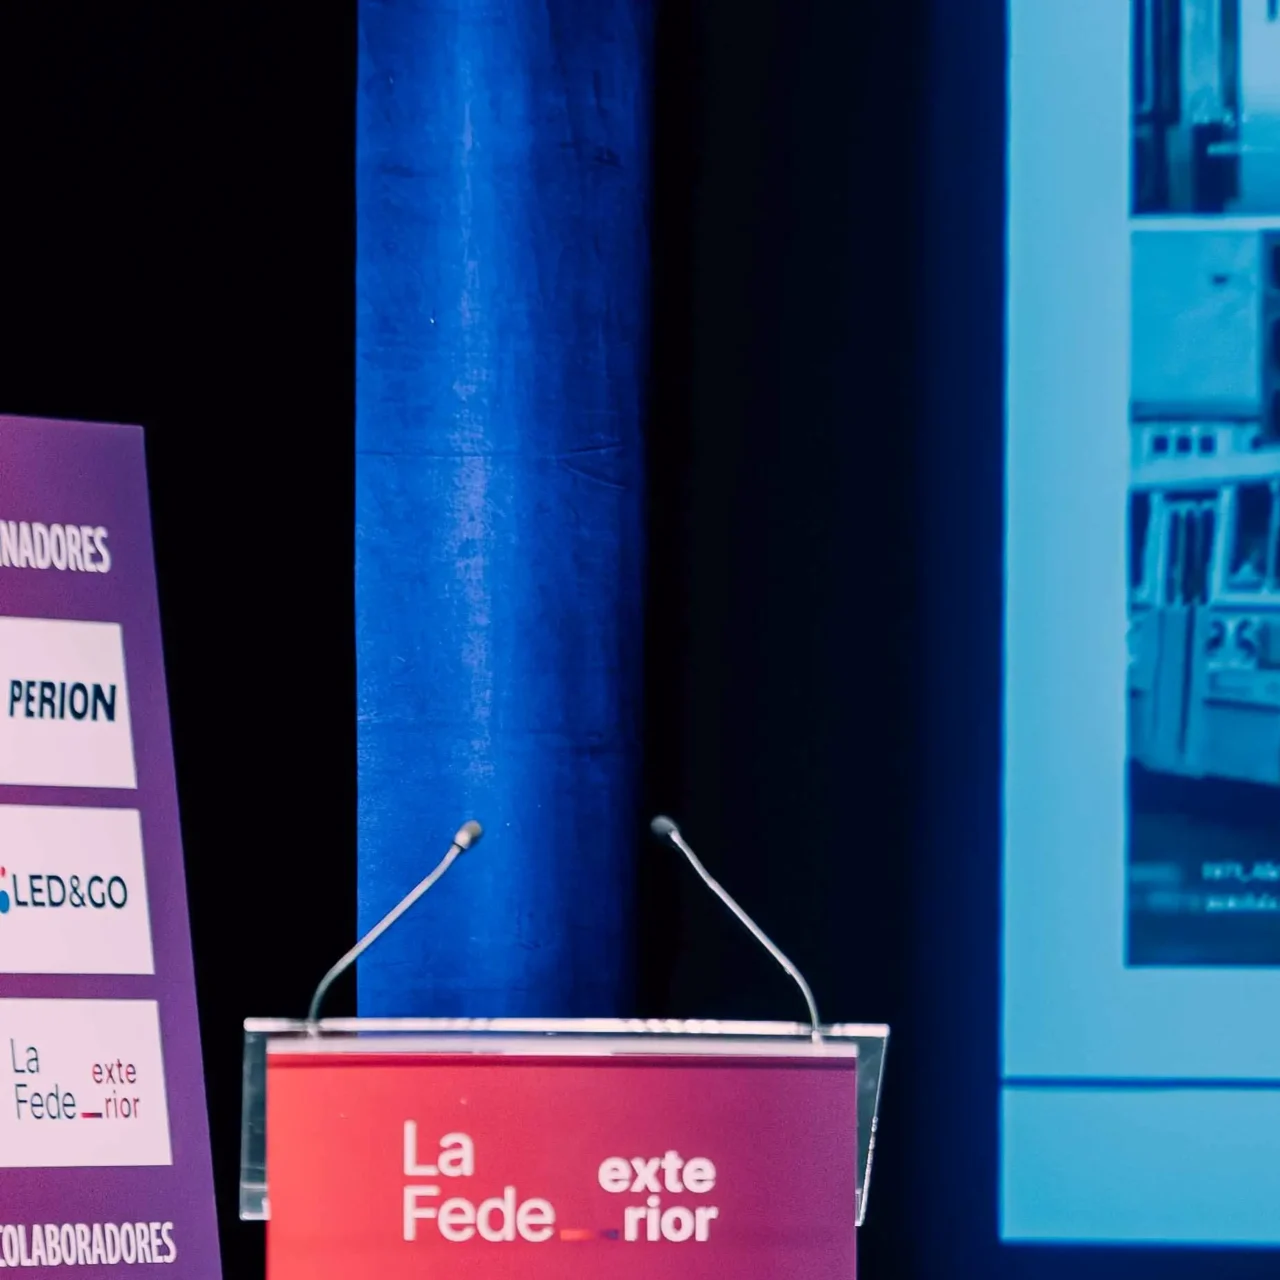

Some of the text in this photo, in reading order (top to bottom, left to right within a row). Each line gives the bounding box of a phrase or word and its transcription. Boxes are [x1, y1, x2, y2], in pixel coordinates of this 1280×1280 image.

[9, 679, 116, 722] PERION
[13, 873, 128, 909] LED&GO
[10, 1038, 40, 1074] La
[92, 1058, 137, 1085] exte
[15, 1082, 140, 1120] Fede rior
[403, 1119, 474, 1177] La
[598, 1150, 717, 1193] exte
[403, 1184, 719, 1242] Fede rior
